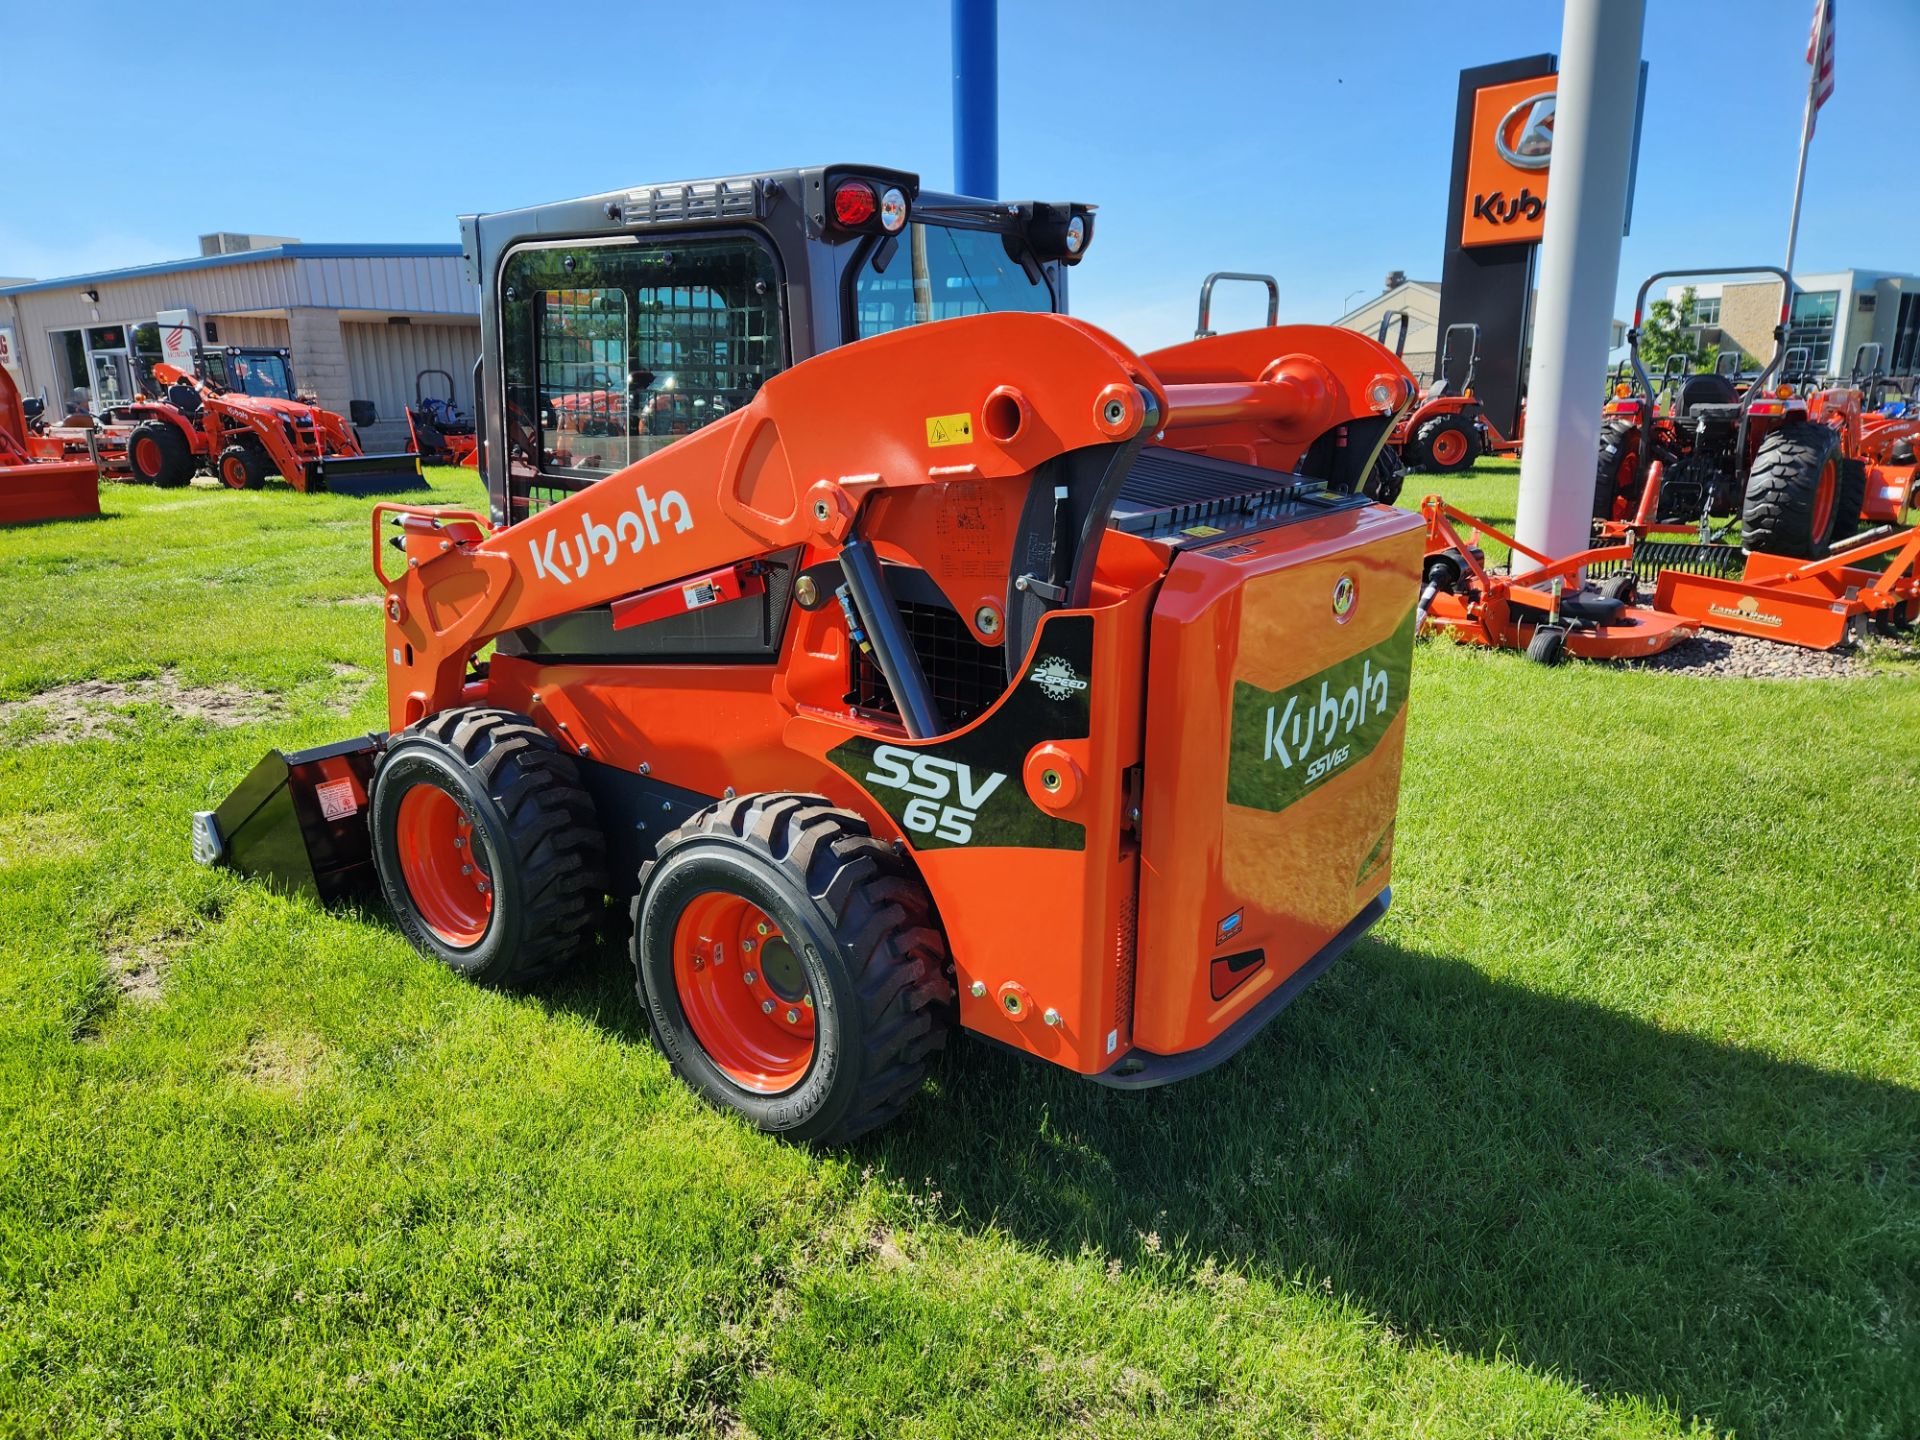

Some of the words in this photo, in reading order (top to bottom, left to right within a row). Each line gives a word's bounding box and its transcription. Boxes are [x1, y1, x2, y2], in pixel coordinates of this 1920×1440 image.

[1473, 188, 1547, 224] Kub
[529, 485, 693, 585] Kubota
[1264, 660, 1388, 769] Kubota
[866, 744, 1007, 810] SSV
[1304, 744, 1351, 785] SSV65
[903, 798, 976, 845] 65
